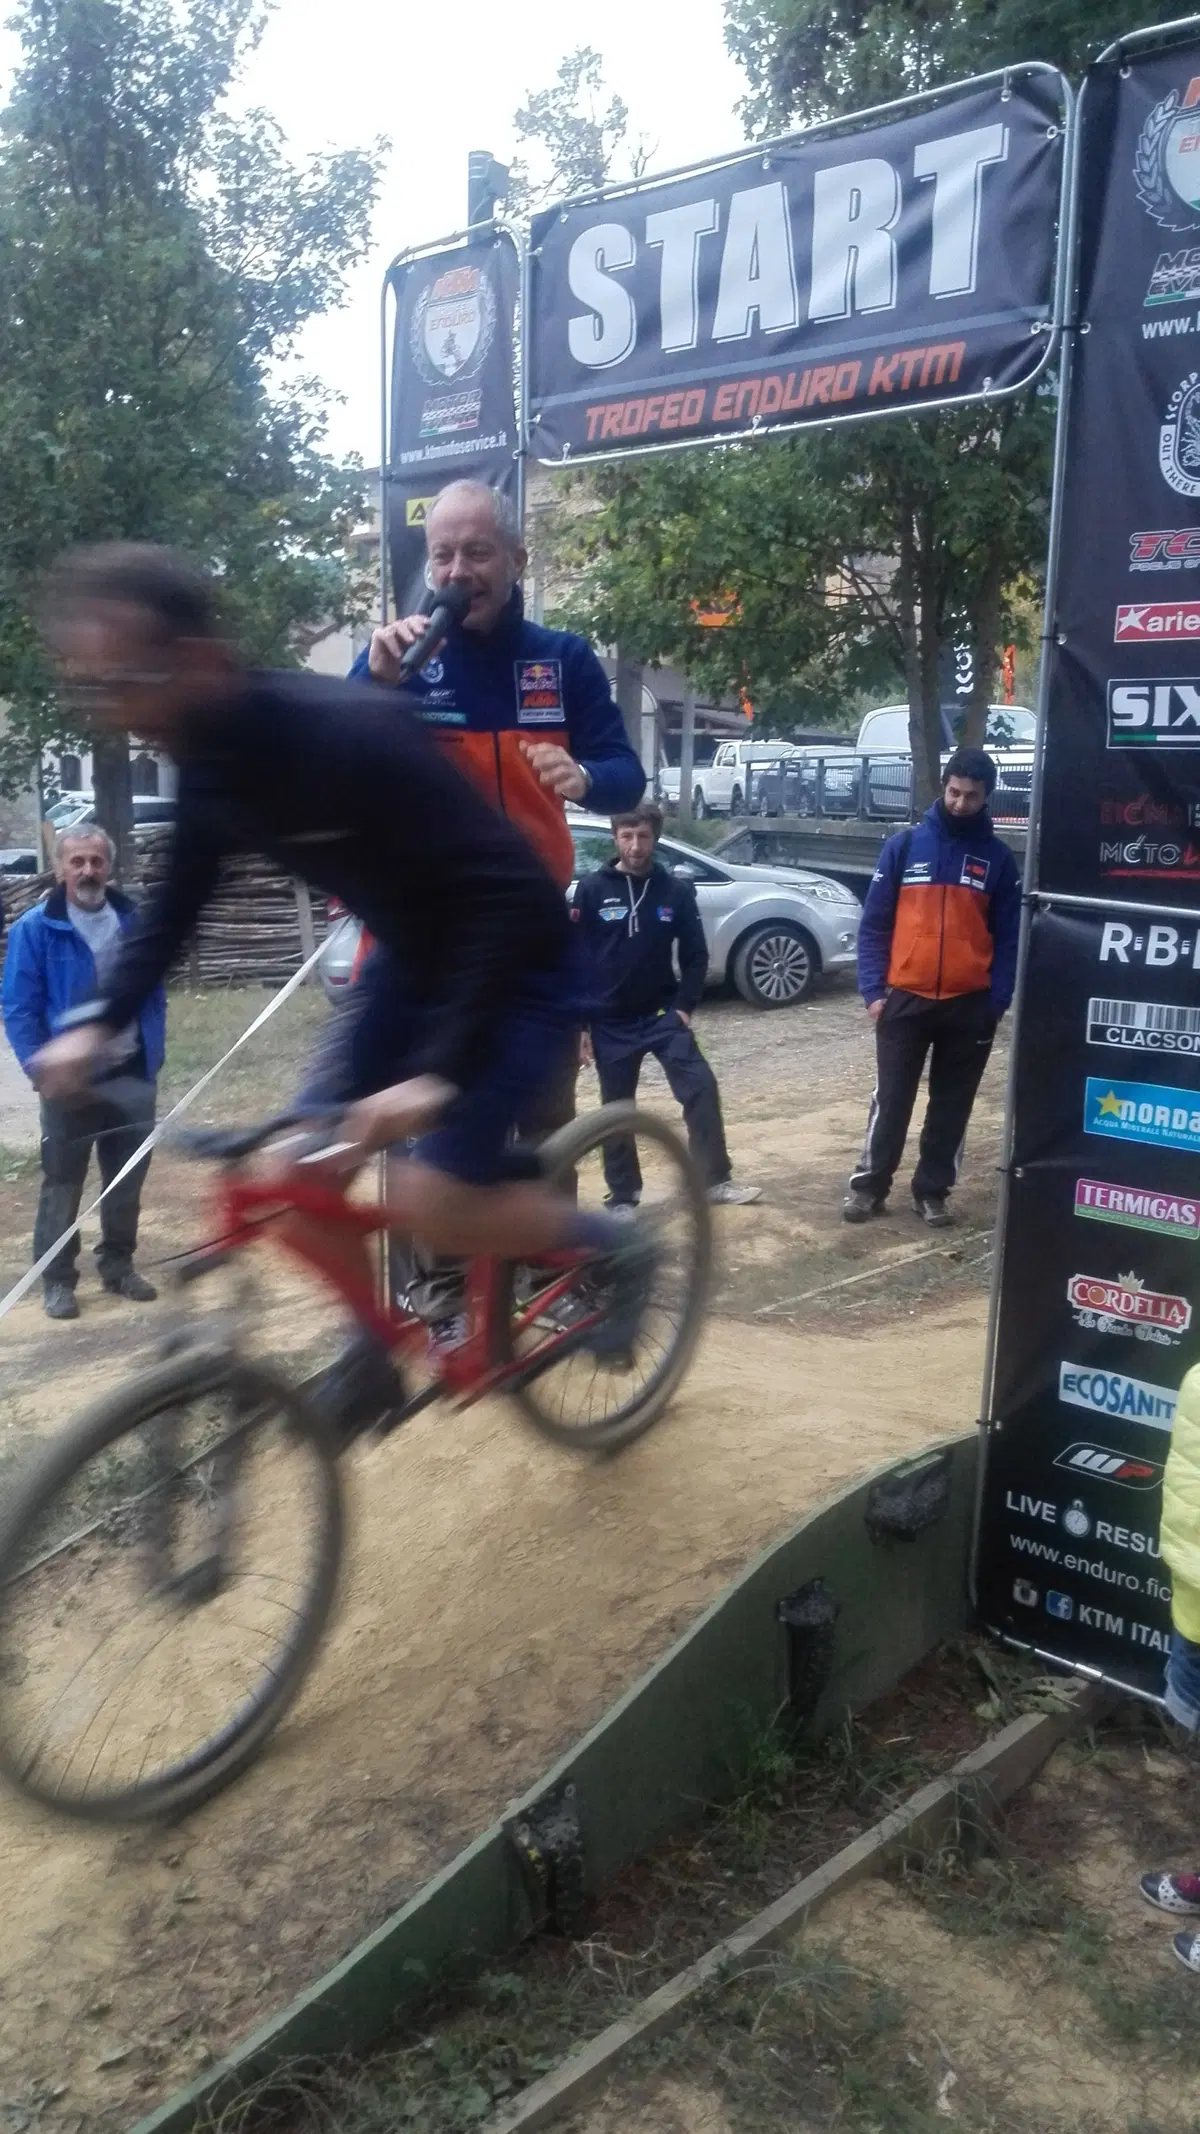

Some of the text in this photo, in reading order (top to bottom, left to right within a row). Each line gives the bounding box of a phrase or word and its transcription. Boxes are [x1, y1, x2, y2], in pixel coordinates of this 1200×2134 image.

[568, 123, 1010, 369] START
[1142, 311, 1200, 339] www.
[586, 341, 966, 441] TROFEO ENDURO KTM
[1112, 686, 1200, 727] SIX
[1082, 1184, 1196, 1225] TERMIGAS
[1073, 1283, 1184, 1323] CORDELIA
[1006, 1491, 1056, 1524] LIVE
[1079, 1604, 1123, 1636] KTM
[1131, 1622, 1172, 1654] ITAL
